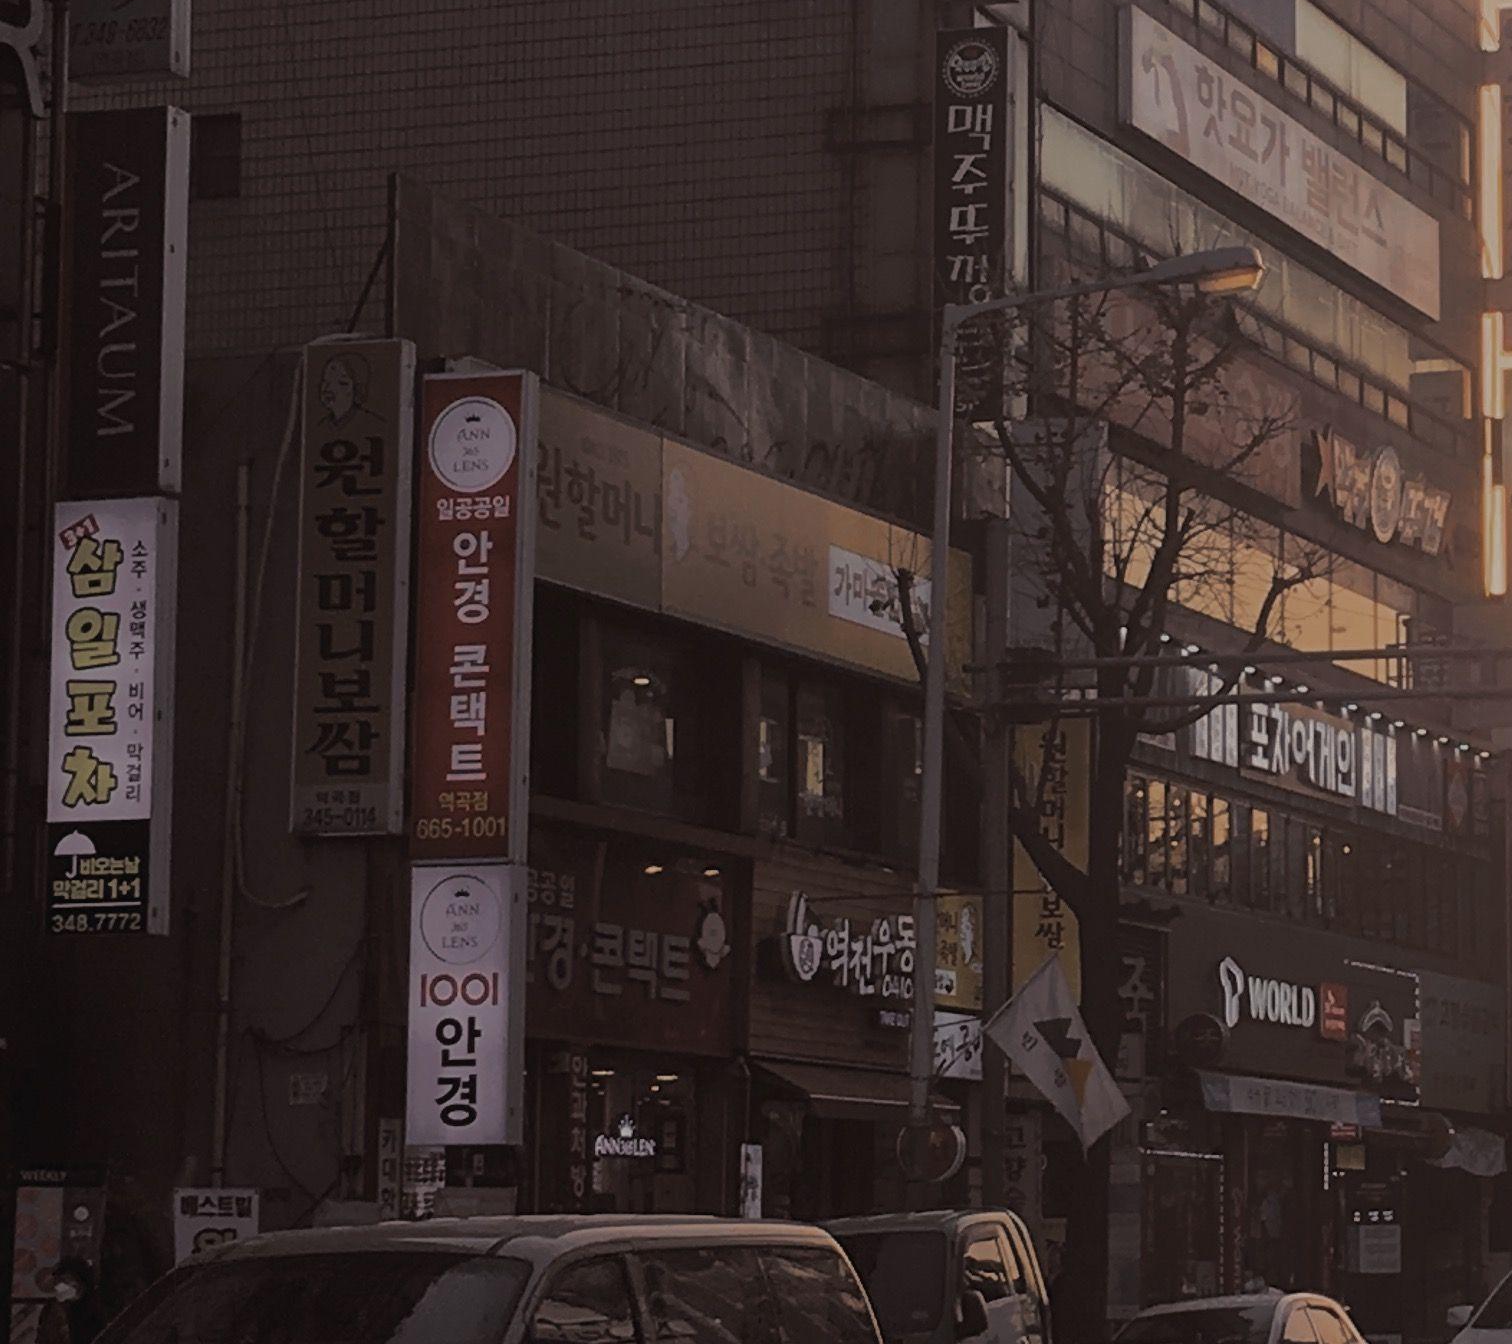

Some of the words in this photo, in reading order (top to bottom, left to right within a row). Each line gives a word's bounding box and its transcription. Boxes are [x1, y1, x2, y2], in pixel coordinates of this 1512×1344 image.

[946, 104, 994, 305] 맥주뚜껑
[96, 161, 141, 437] ARITAUM
[436, 494, 511, 522] 일공공일
[131, 540, 148, 579] 소주
[451, 529, 495, 626] 안경
[61, 534, 125, 809] 삼일포차
[445, 643, 491, 783] 콘택트
[415, 815, 507, 840] 665-1001
[437, 791, 490, 813] 역곡점
[107, 876, 141, 899] 1+1
[51, 911, 142, 933] 348.7772
[825, 914, 917, 996] 역전우동
[419, 972, 499, 1008] 1001
[1248, 976, 1316, 1030] WORLD
[435, 1016, 483, 1127] 안경
